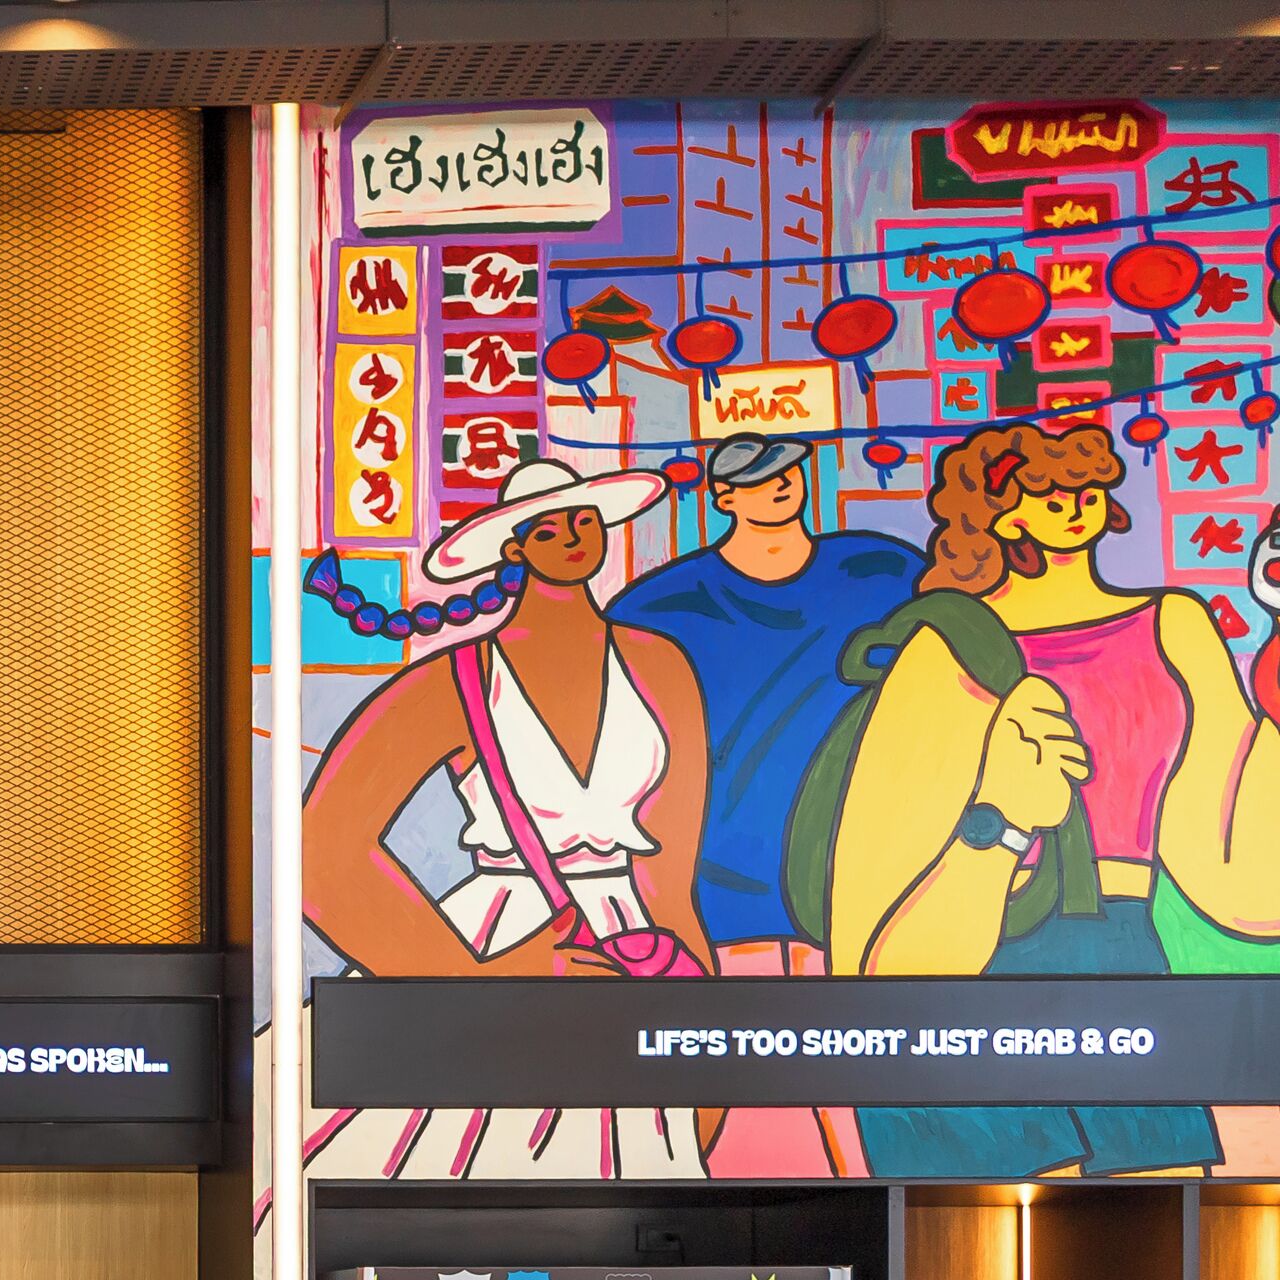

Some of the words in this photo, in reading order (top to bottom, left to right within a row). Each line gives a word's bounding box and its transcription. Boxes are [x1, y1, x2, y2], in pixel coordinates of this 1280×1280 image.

[638, 1029, 727, 1056] LIFE'S
[732, 1029, 798, 1056] TOO
[802, 1029, 907, 1056] SHORT
[911, 1029, 989, 1056] JUST
[992, 1028, 1076, 1056] GRAB
[1080, 1029, 1104, 1055] &
[1109, 1028, 1155, 1055] GO
[30, 1048, 168, 1073] SPOKEN...
